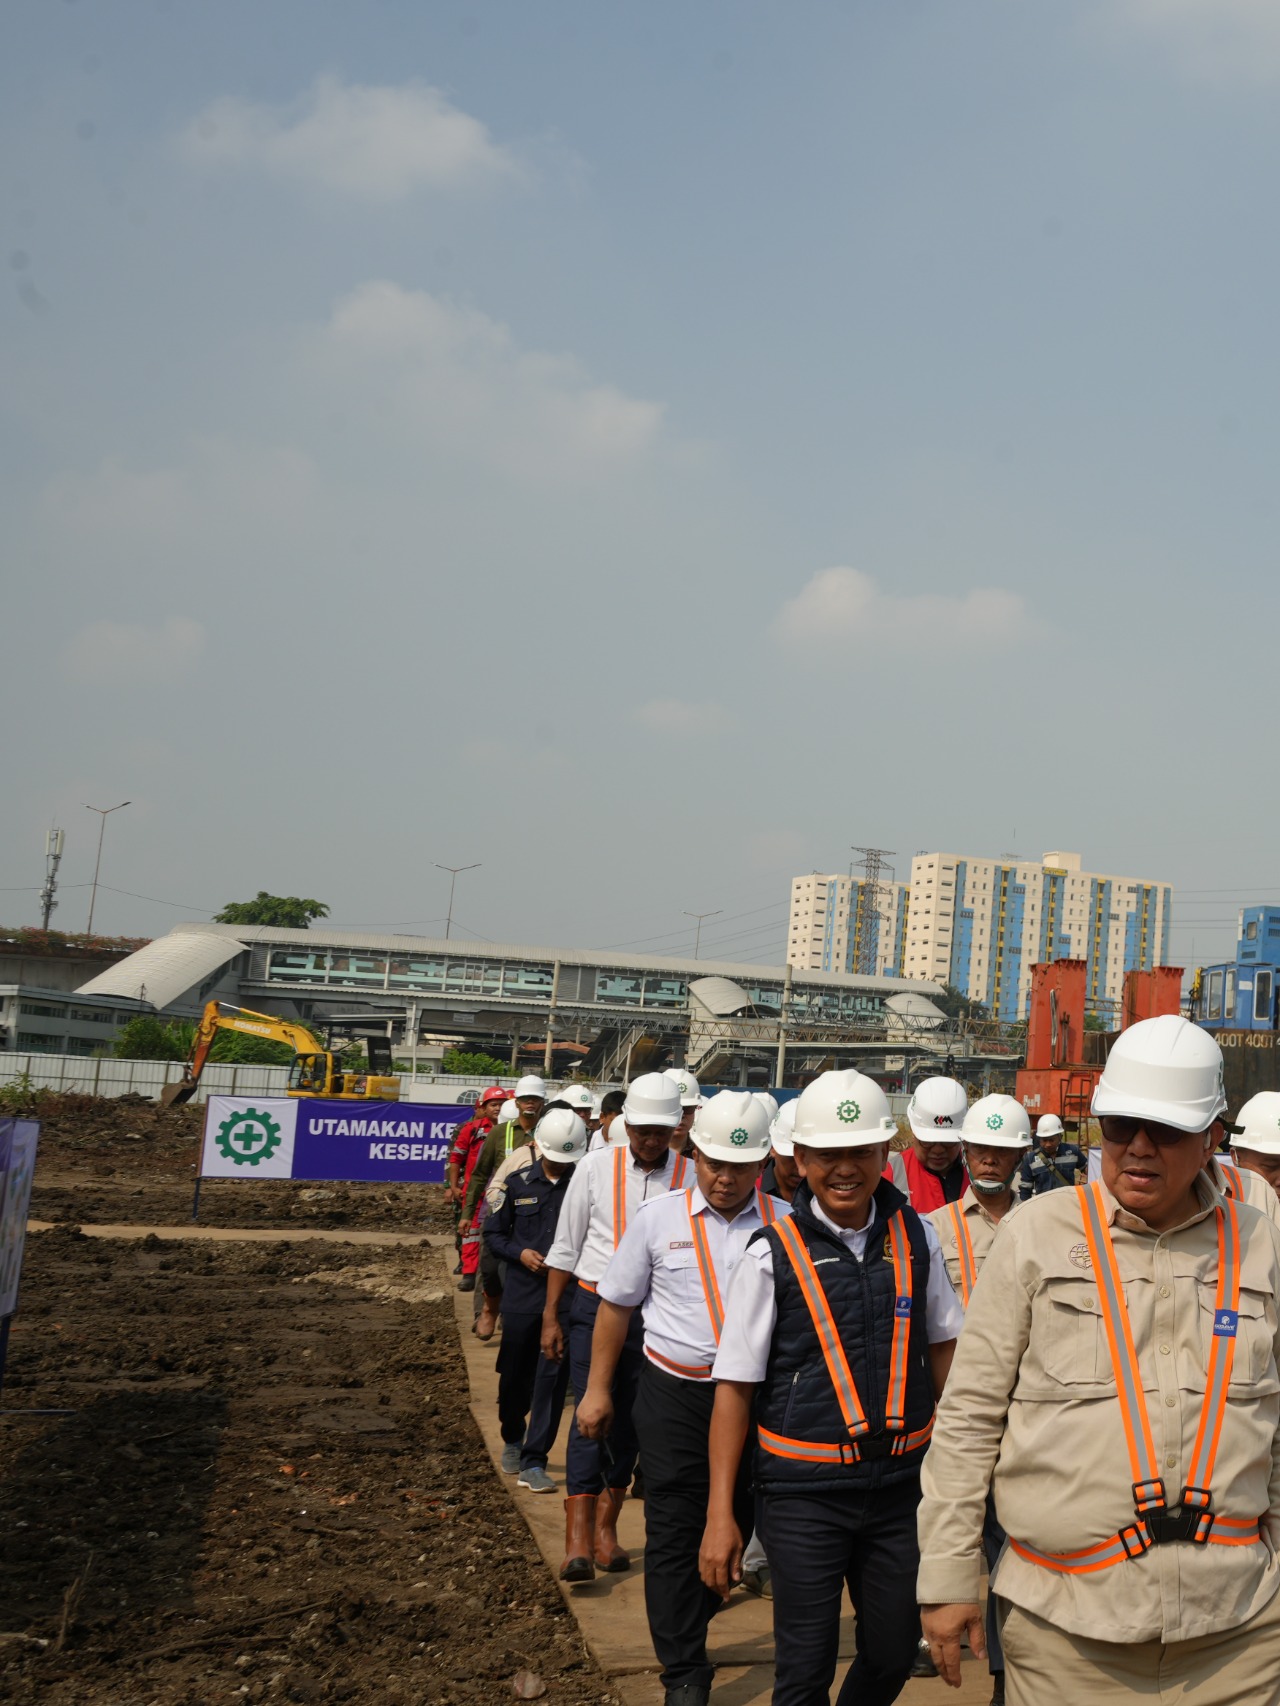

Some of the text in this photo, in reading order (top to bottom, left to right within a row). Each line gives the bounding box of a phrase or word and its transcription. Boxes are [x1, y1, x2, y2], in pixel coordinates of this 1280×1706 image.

[233, 1021, 272, 1035] KOMATSU
[308, 1118, 424, 1138] UTAMAKAN
[369, 1143, 449, 1161] KESEHA
